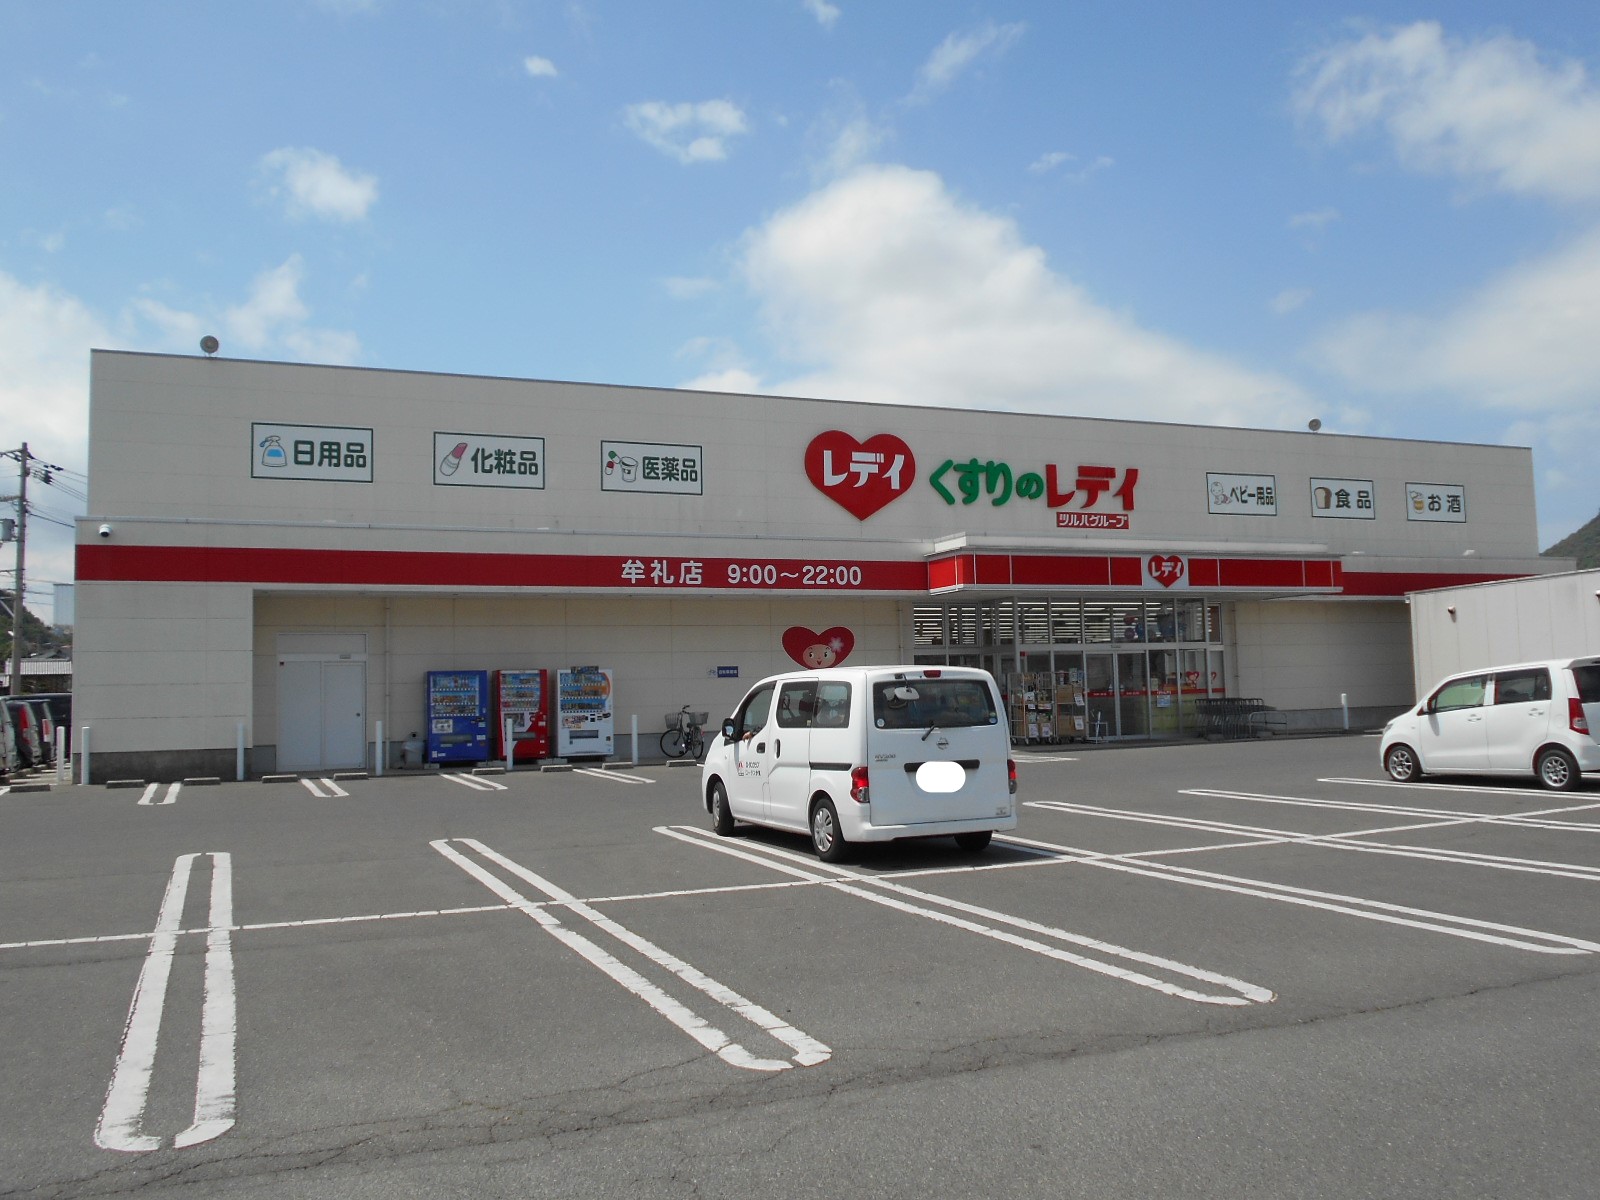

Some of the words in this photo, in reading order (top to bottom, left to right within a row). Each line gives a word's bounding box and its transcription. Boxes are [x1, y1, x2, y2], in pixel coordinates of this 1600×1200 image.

[293, 439, 367, 468] 日用品
[470, 447, 539, 476] 化粧品
[642, 456, 698, 482] 医薬品
[1230, 485, 1274, 506] ベビー用品
[1335, 488, 1372, 509] 食品
[1427, 493, 1461, 513] お酒
[1058, 513, 1127, 528] ツルハグループ
[621, 559, 703, 585] 牟礼店
